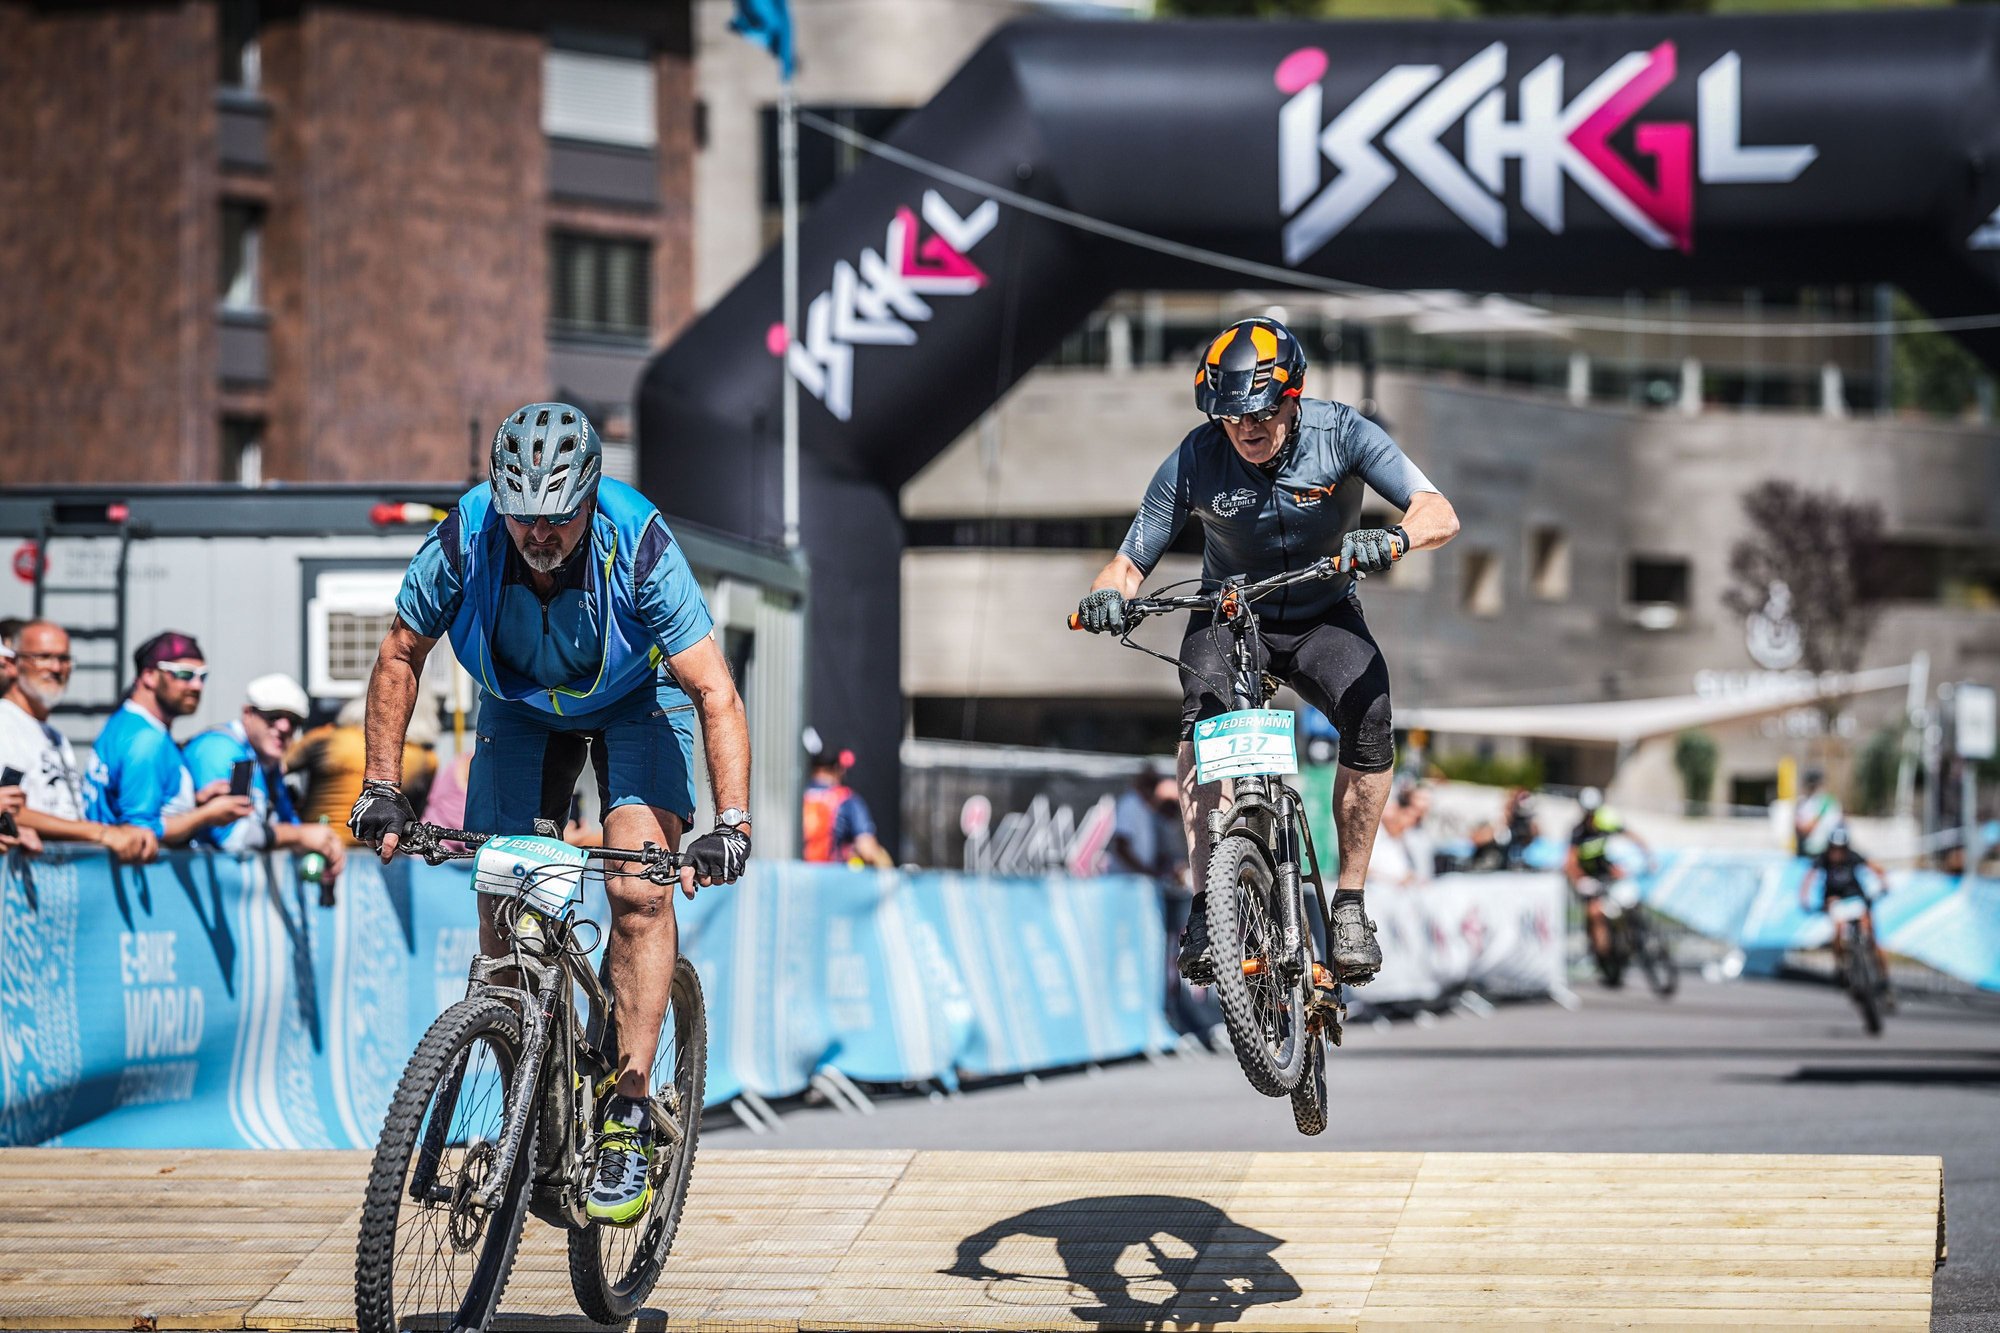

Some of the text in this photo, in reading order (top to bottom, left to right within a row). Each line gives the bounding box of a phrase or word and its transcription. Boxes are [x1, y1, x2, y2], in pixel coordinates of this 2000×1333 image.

[1221, 498, 1257, 509] SPEEDHUB
[1218, 717, 1291, 731] JEDERMANN
[1228, 736, 1268, 754] 137
[507, 838, 585, 866] JEDERMANN
[120, 931, 177, 984] E-BIKE
[123, 986, 205, 1060] WORLD
[488, 1020, 519, 1045] MAXXIS
